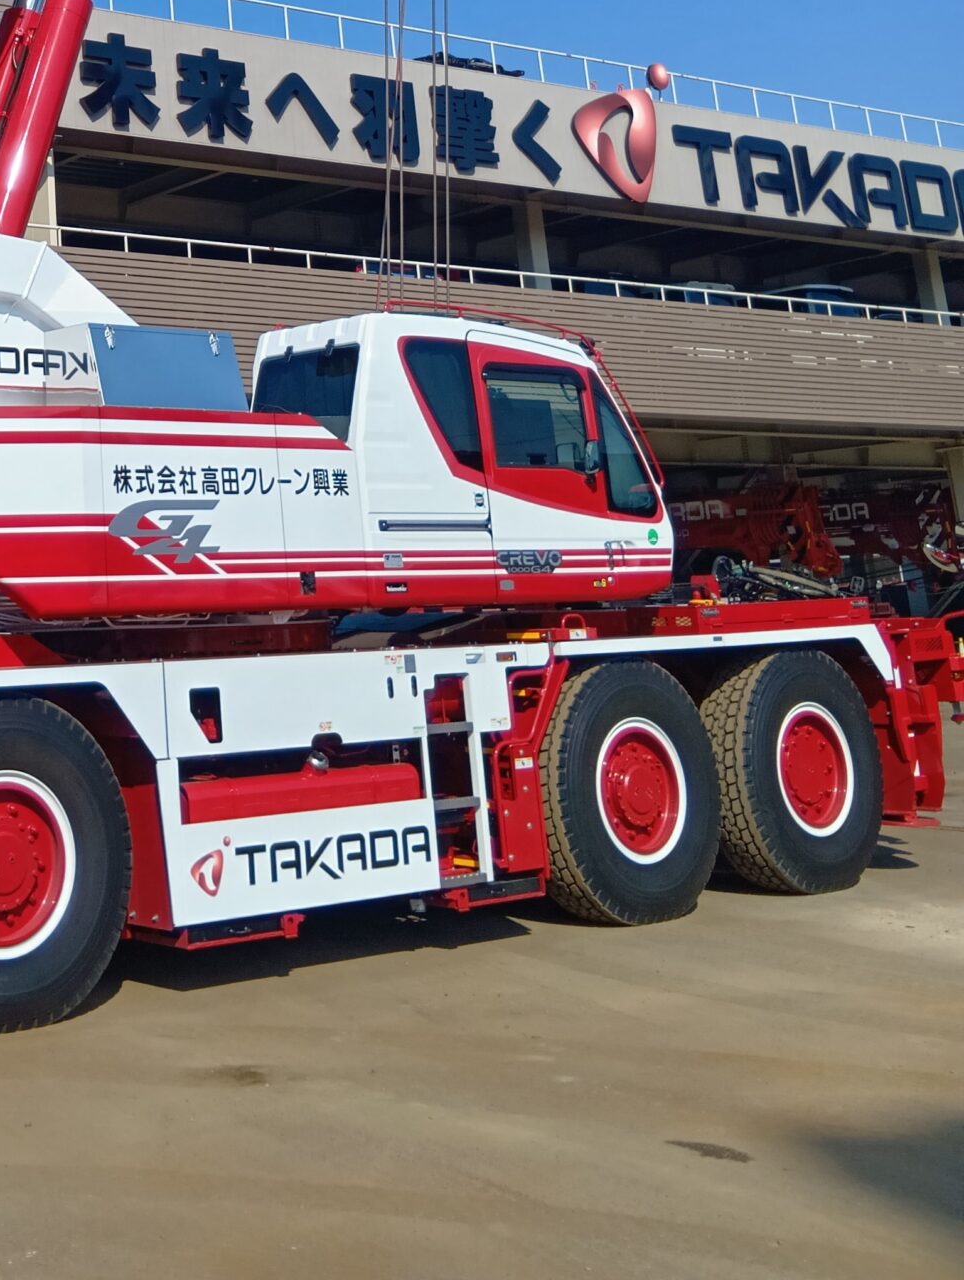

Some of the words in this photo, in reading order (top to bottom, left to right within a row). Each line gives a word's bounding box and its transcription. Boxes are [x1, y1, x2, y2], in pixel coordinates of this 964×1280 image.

[79, 32, 563, 185] 未来へ羽撃く
[113, 465, 350, 497] 株式会社高田クレーン興業
[108, 499, 221, 564] G4
[496, 550, 563, 566] CREVO
[235, 825, 432, 886] TAKADA
